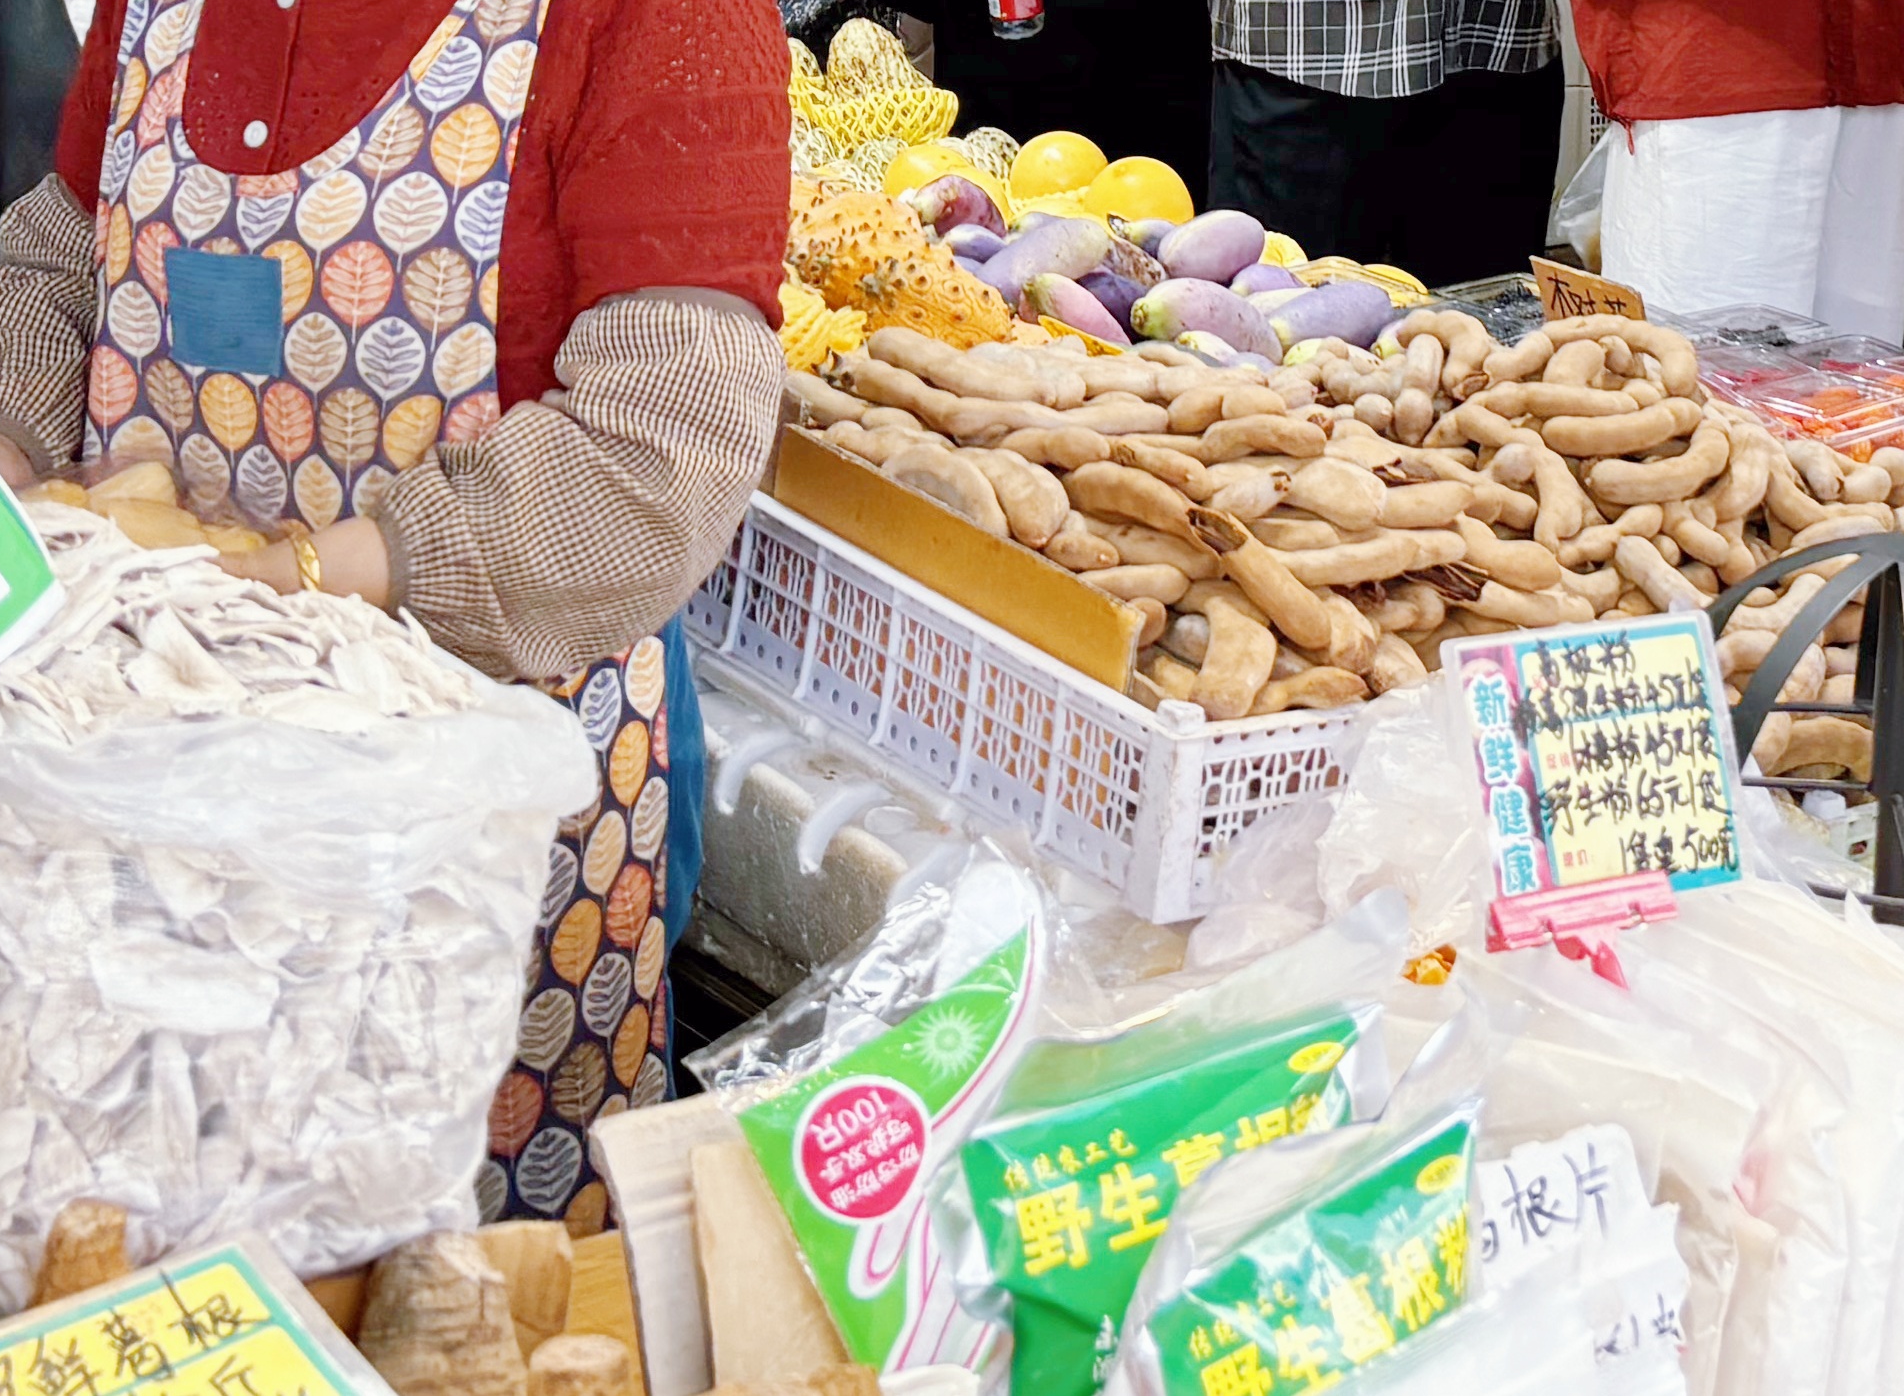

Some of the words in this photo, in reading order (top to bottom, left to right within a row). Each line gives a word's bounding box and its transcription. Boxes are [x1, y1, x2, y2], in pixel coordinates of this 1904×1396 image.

[1471, 676, 1536, 893] 新鲜健康
[809, 1089, 889, 1153] 100只
[818, 1118, 913, 1185] 呵护双手
